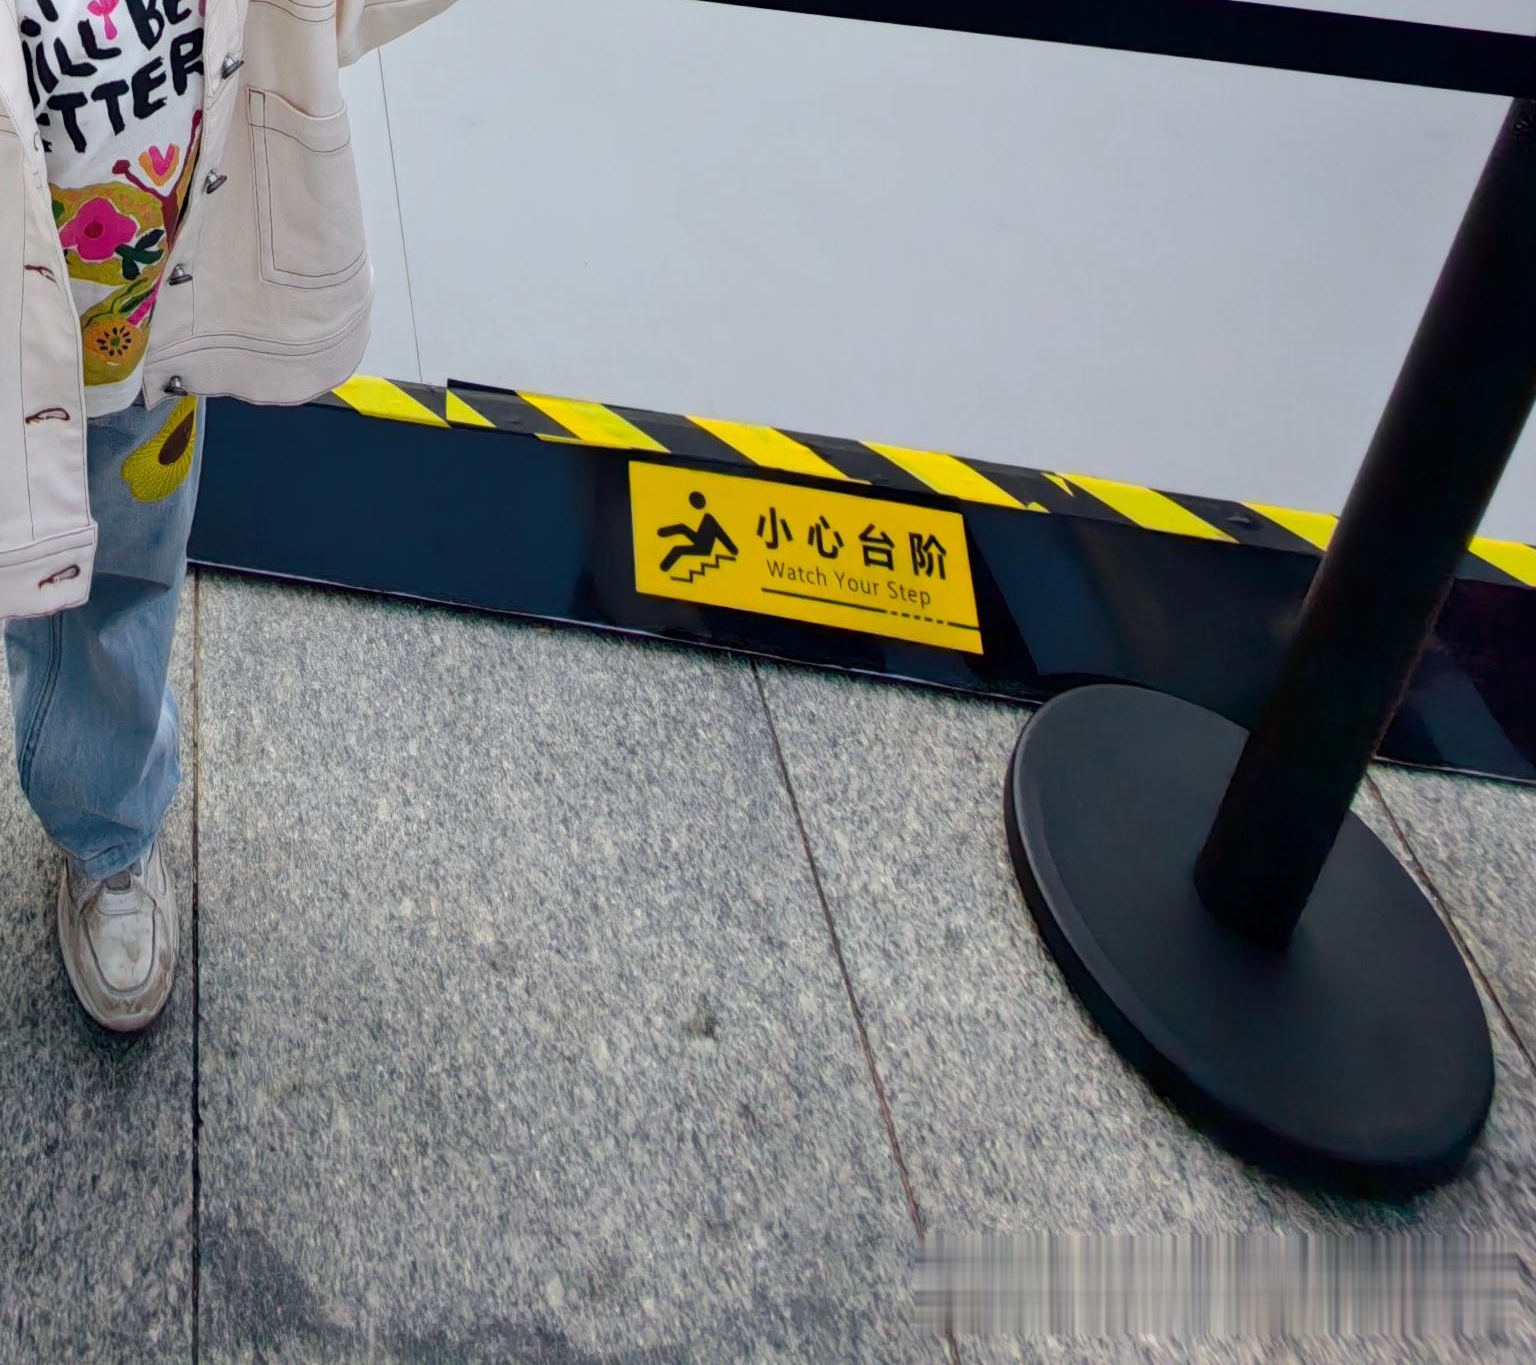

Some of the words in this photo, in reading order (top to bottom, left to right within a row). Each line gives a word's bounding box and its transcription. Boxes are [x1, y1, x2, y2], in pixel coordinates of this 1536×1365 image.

[756, 507, 947, 580] 小心台阶
[766, 559, 827, 587] Watch
[834, 571, 879, 596] Your
[888, 581, 932, 609] Step
